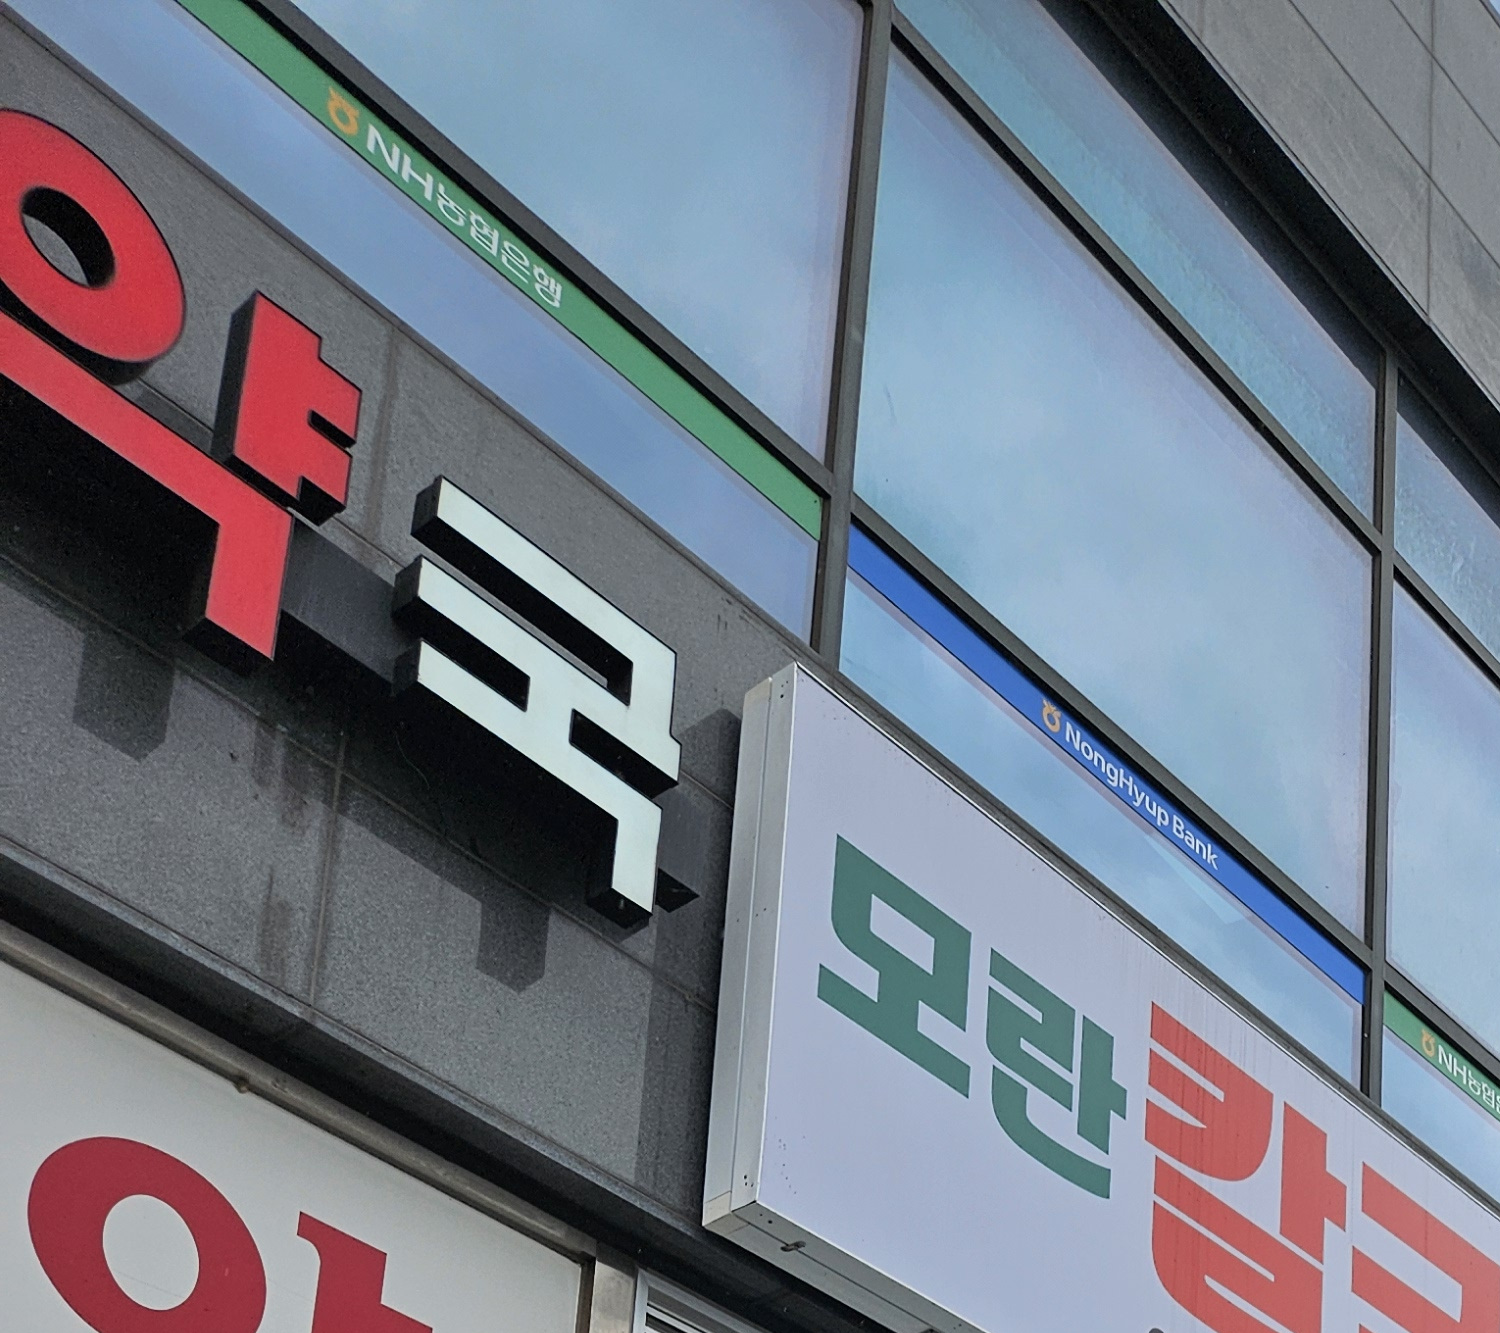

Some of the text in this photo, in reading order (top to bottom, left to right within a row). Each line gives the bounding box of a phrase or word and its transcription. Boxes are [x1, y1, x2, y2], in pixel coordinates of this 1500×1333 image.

[366, 123, 565, 309] NH농협은행
[1064, 717, 1220, 872] NongHyup Bank
[817, 833, 1127, 1199] 모란
